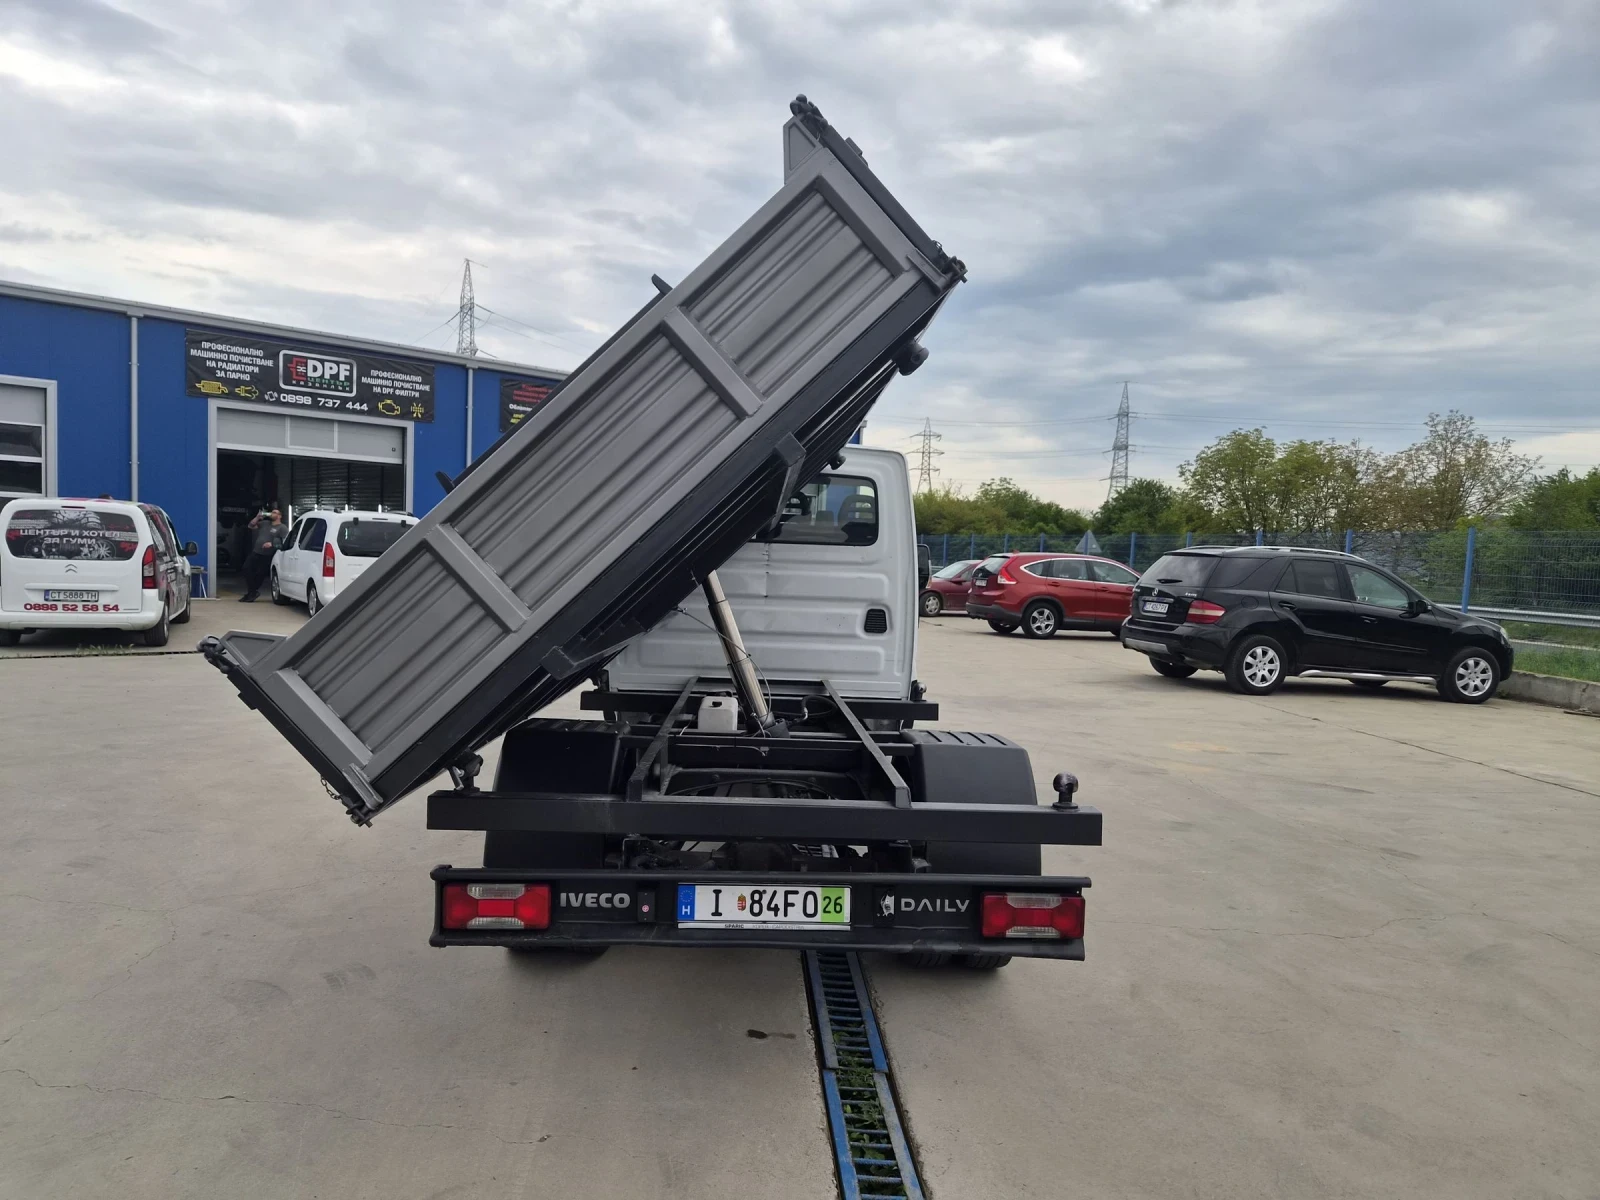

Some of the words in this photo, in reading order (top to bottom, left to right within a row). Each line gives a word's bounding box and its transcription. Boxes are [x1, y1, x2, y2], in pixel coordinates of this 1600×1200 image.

[202, 342, 263, 356] ПРОФЕСИОНАЛНО
[191, 349, 228, 360] МАШИННО
[230, 354, 274, 366] ПОЧИСТВАНЕ
[218, 362, 259, 373] РАДИАТОРИ
[307, 359, 350, 381] DPF
[227, 372, 250, 380] ПАРНО
[371, 370, 422, 382] ПРОФЕСИОНАЛНО
[362, 377, 392, 386] МАШИННО
[394, 381, 430, 391] ПОЧИСТВАНЕ
[395, 389, 419, 397] ФИЛТРИ
[280, 394, 312, 404] 0898
[317, 398, 340, 408] 737
[346, 402, 368, 410] 444
[24, 603, 58, 611] 0898
[82, 604, 98, 612] 58
[560, 892, 630, 908] IVECO
[682, 905, 690, 915] H
[823, 896, 842, 914] 26
[901, 898, 970, 912] DAILY
